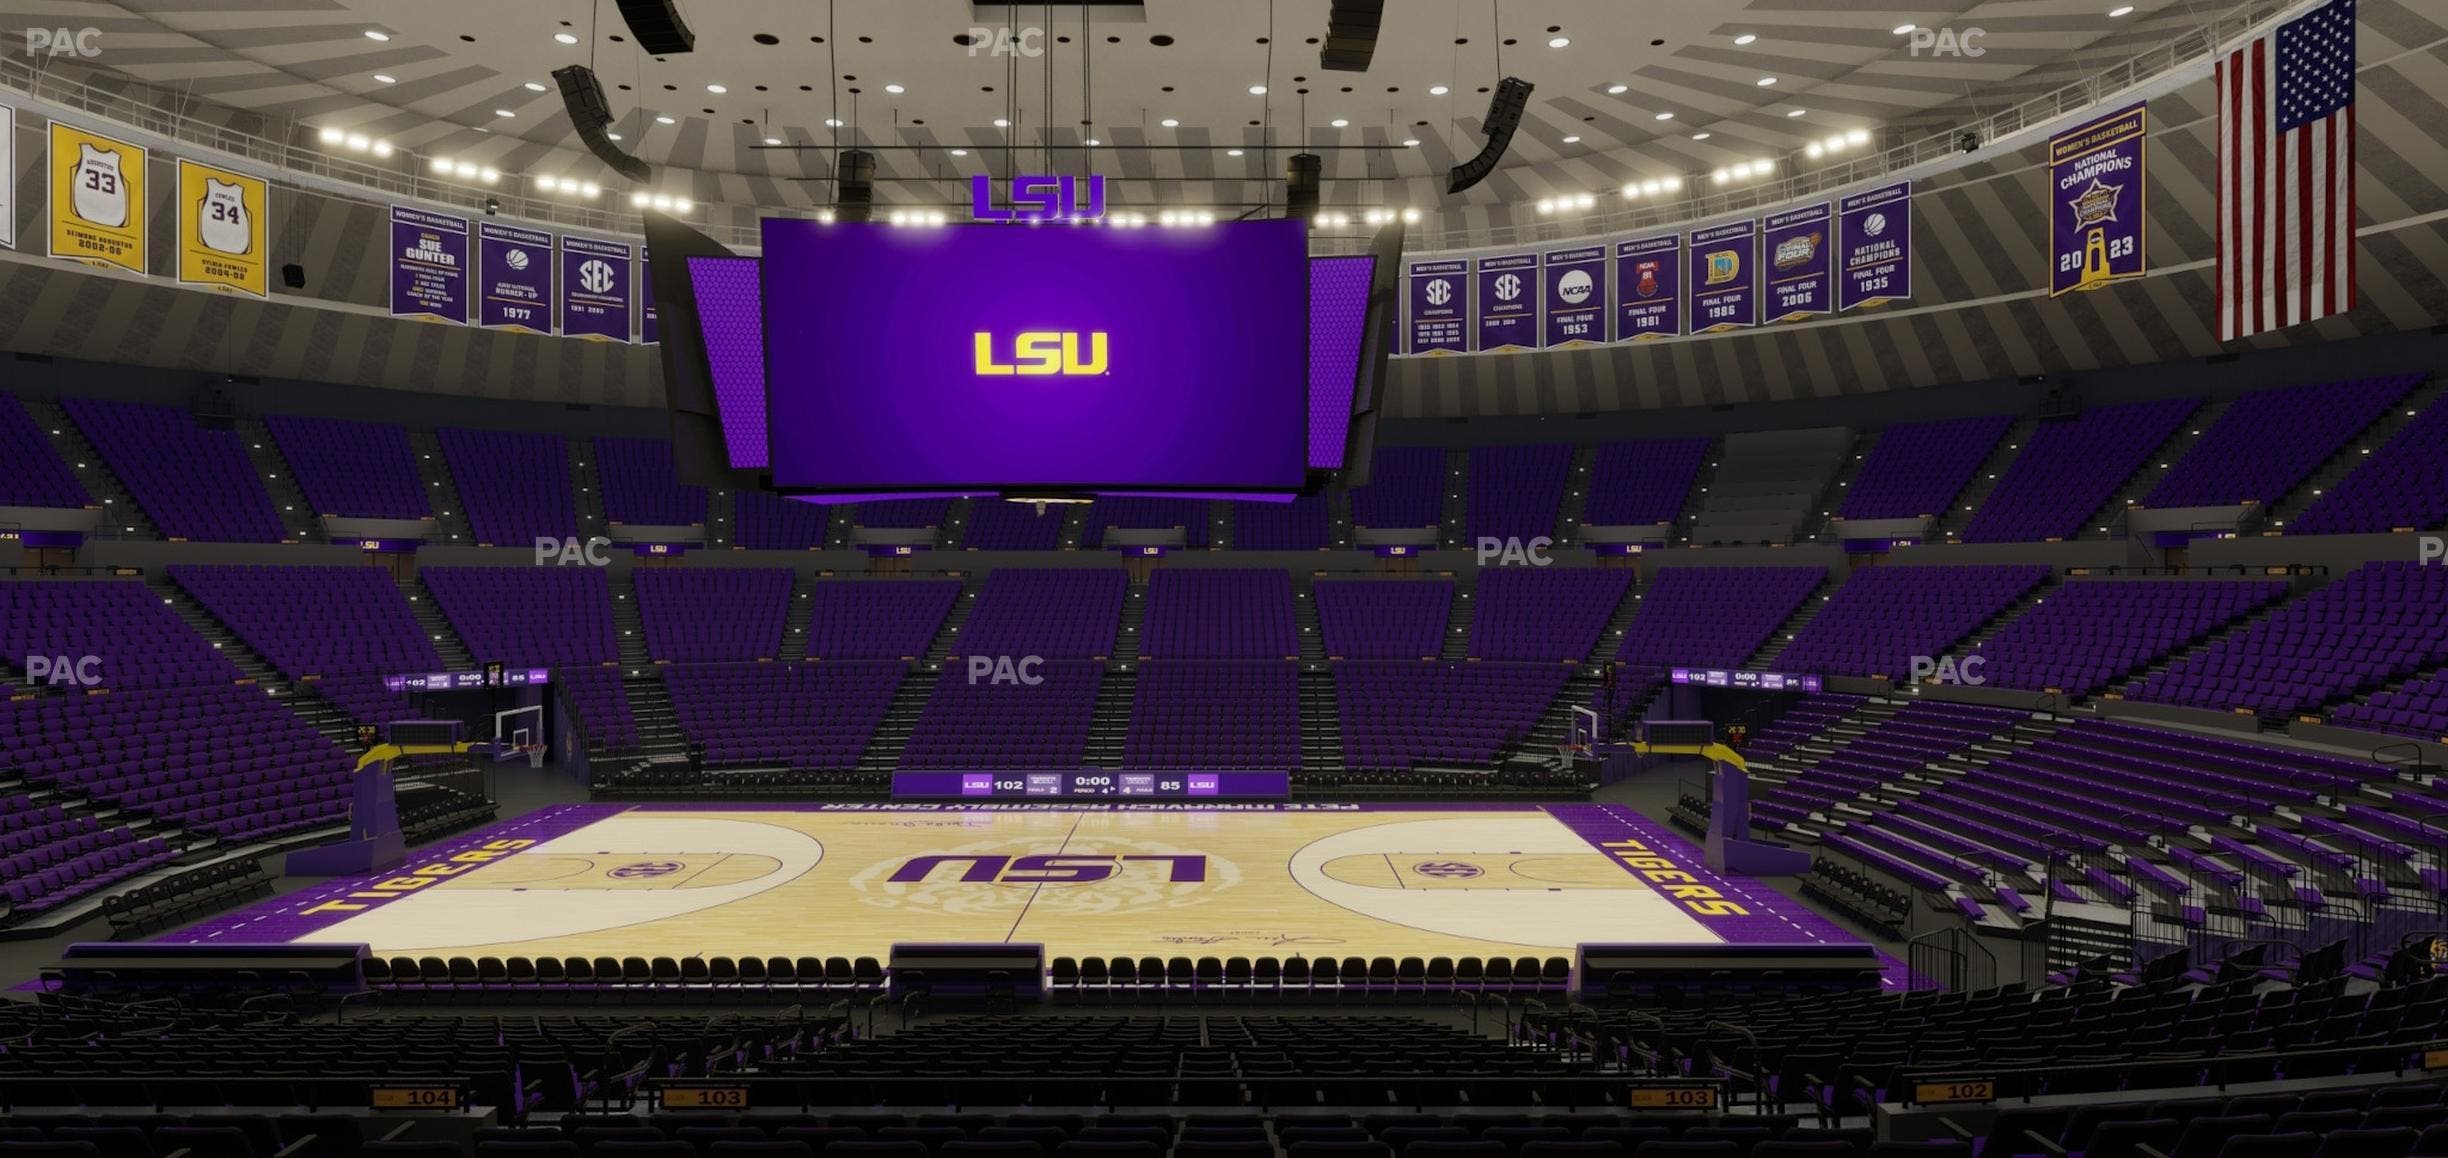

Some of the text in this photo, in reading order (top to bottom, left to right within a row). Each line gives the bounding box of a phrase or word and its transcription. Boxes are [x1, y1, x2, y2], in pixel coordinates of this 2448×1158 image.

[2056, 119, 2138, 156] WOMEN'S BASKETBALL
[2074, 149, 2118, 170] NATIONAL
[2060, 156, 2132, 189] CHAMPIONS
[85, 168, 115, 195] 33
[972, 175, 1107, 221] LSU
[1848, 188, 1902, 208] MEN'S BASKETBALL
[211, 201, 239, 225] 34
[395, 209, 465, 229] WOMEN'S BASKETBALL
[1772, 209, 1823, 225] MEN'S BASKETBALL
[484, 227, 549, 243] WOMEN'S BASKETBALL
[1697, 225, 1747, 240] MEN'S BASKETBALL
[419, 238, 442, 253] SUE
[566, 240, 627, 254] WOMEN'S BASKETBALL
[1623, 240, 1672, 252] MEN'S BASKETBALL
[1855, 240, 1895, 256] NATIONAL
[405, 247, 455, 265] GUNTER
[1569, 251, 1599, 259] BASKETBALL
[1778, 249, 1811, 260] FOUR
[1850, 247, 1900, 266] CHAMPIONS
[2060, 235, 2134, 272] 20 23
[1503, 258, 1531, 266] BASKETBALL
[579, 259, 615, 293] SEC
[1642, 271, 1652, 279] 81
[1853, 264, 1895, 280] FINAL FOUR
[1426, 279, 1451, 305] SEC
[1495, 274, 1521, 300] SEC
[1563, 285, 1591, 296] NCAA
[1777, 281, 1817, 294] FINAL FOUR
[1860, 277, 1888, 292] 1935
[1703, 294, 1741, 307] FINAL FOUR
[1782, 292, 1812, 307] 2006
[503, 307, 531, 320] 1977
[1557, 314, 1593, 323] FINAL FOUR
[1628, 306, 1666, 316] FINAL FOUR
[1709, 305, 1735, 318] 1986
[1637, 316, 1659, 327] 1981
[1563, 324, 1588, 335] 1953
[974, 332, 1108, 375] LSU
[651, 545, 667, 553] LSU
[1688, 673, 1705, 681] 102
[1735, 673, 1756, 681] 0:00
[964, 781, 989, 789] LSU
[994, 780, 1023, 790] 102
[1076, 776, 1110, 785] 0:00
[1160, 781, 1180, 790] 85
[1190, 781, 1215, 789] LSU
[821, 803, 1360, 812] PETE MARAVICH ASSEMBLY CENTER
[887, 855, 1206, 882] LSU
[298, 839, 537, 916] TIGERS
[1601, 839, 1750, 915] TIGERS
[408, 1091, 450, 1104] 104
[698, 1091, 741, 1104] 103
[1665, 1091, 1708, 1104] 103
[1948, 1084, 1987, 1099] 102
